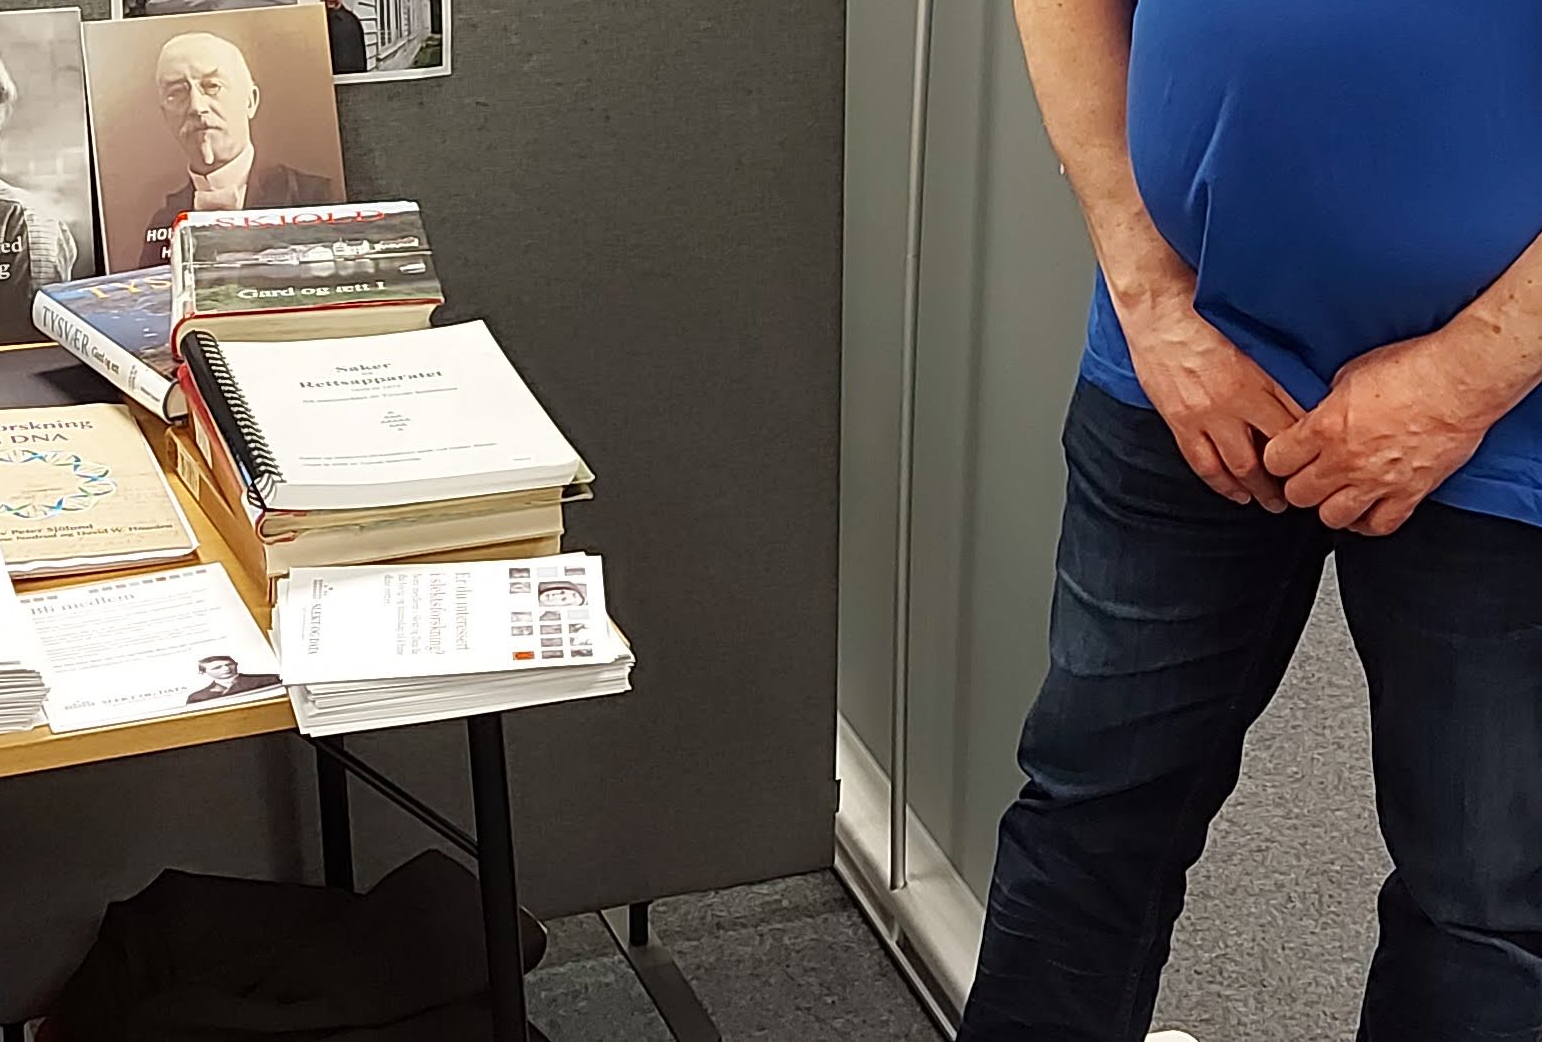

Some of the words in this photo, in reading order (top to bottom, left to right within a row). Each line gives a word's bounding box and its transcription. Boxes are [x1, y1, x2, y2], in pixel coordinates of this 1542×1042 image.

[213, 210, 386, 229] SKJOLD
[236, 287, 294, 300] Gard
[296, 285, 330, 298] og
[42, 305, 90, 357] TYSVÆR
[10, 433, 69, 444] DNA
